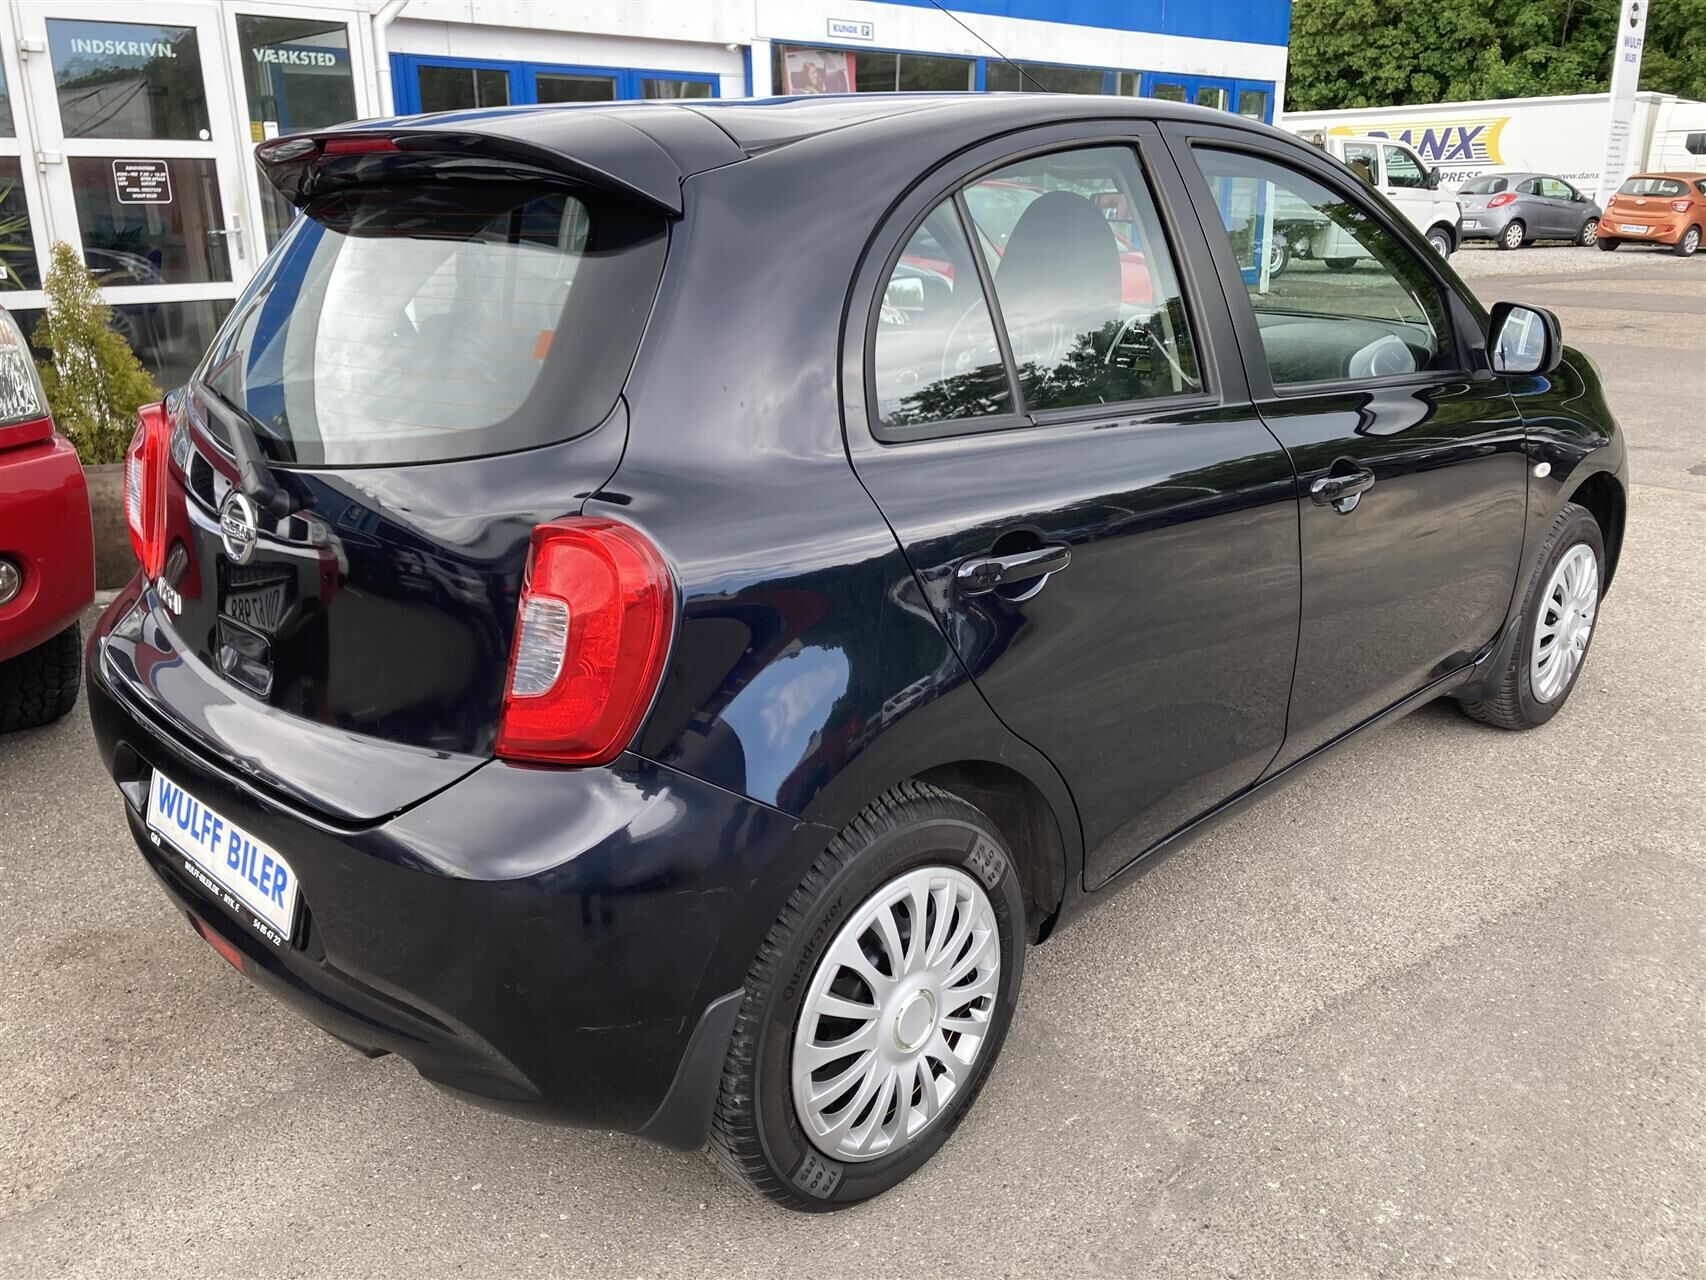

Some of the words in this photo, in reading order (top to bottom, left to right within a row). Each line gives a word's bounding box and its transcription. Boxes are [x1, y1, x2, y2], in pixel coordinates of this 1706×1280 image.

[70, 38, 177, 58] INDSKRIVN.
[252, 47, 336, 66] VÆRKSTED
[1367, 125, 1486, 160] NX
[159, 777, 223, 854] WULFF
[226, 829, 288, 910] BILER
[273, 935, 281, 946] 22
